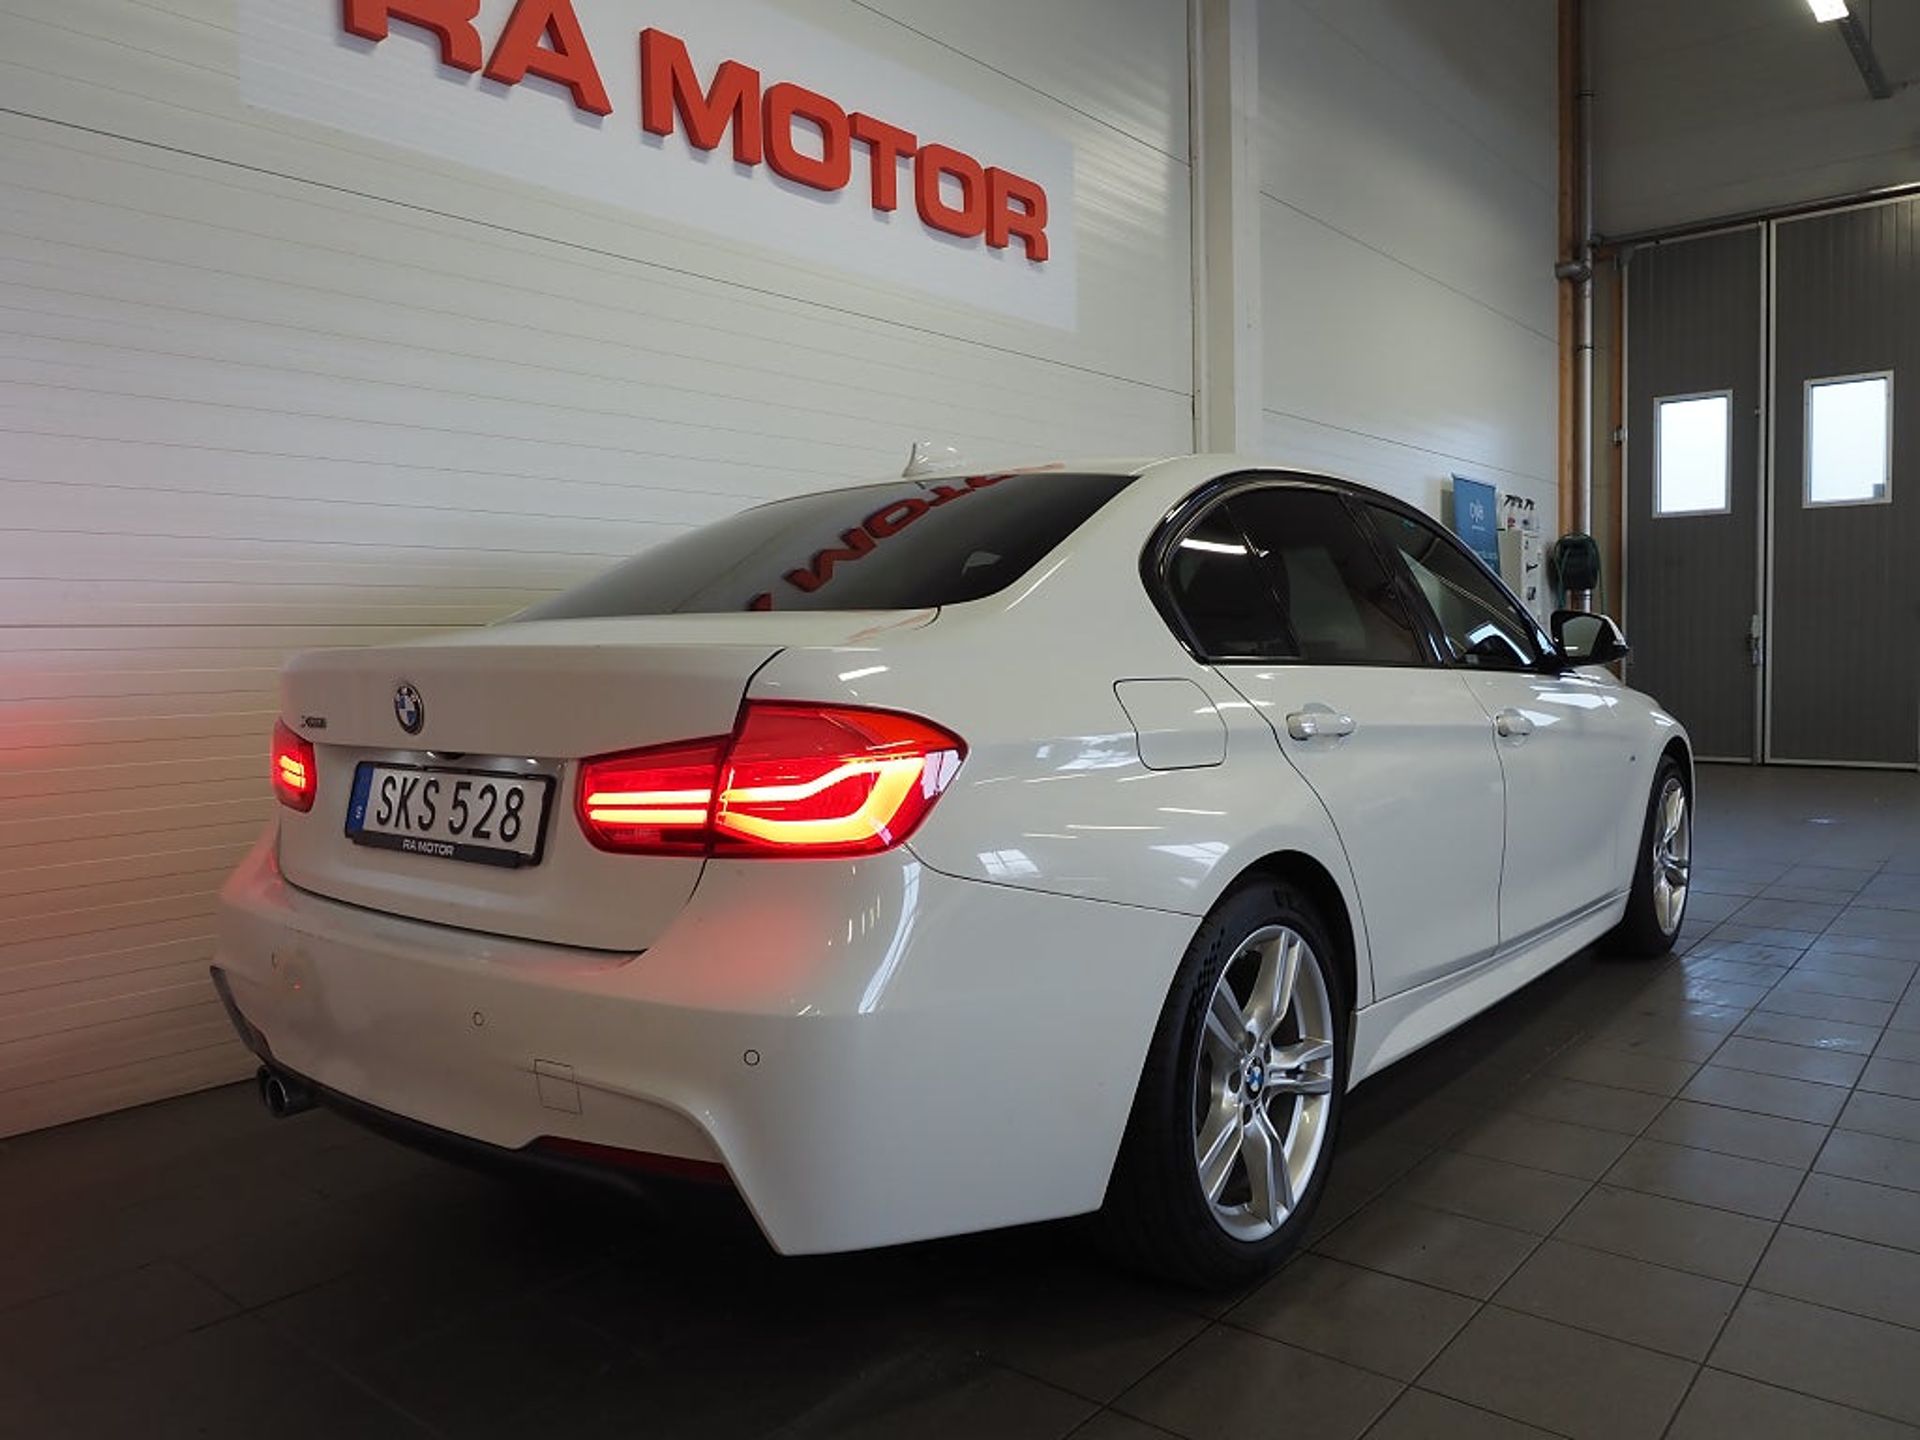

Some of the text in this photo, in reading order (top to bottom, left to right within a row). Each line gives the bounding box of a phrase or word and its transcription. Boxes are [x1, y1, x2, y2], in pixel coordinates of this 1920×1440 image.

[639, 27, 1049, 263] MOTOR
[376, 775, 525, 842] SKS 528
[402, 838, 454, 857] RA MOTOR
